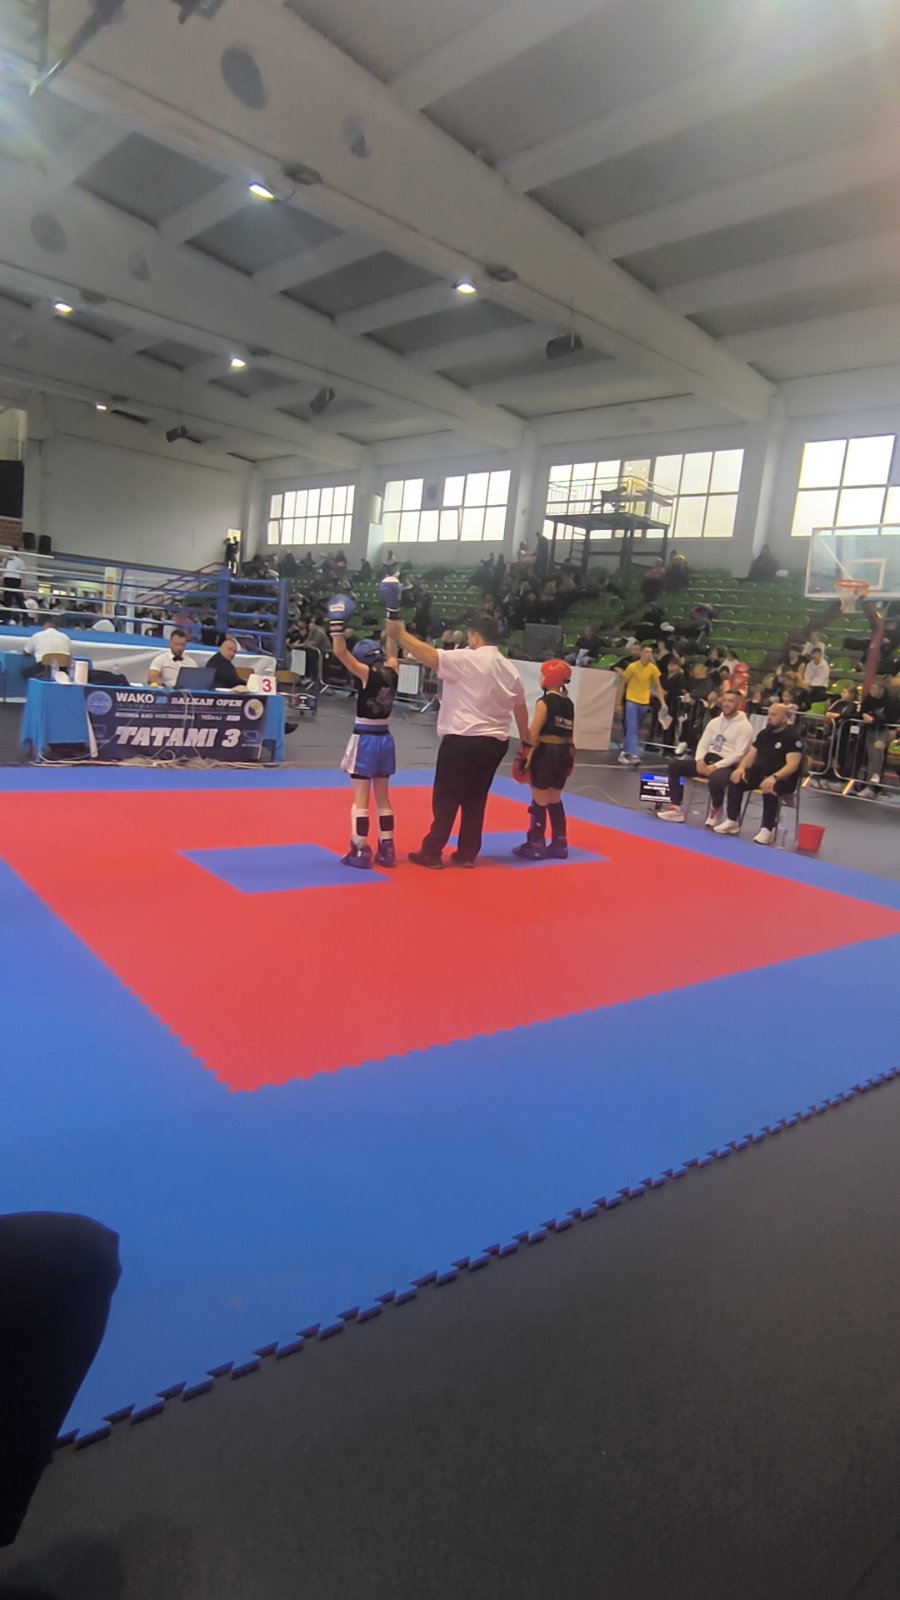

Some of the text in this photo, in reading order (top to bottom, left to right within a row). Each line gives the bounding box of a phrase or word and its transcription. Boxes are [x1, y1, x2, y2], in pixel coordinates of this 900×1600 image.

[262, 678, 272, 693] 3
[115, 692, 155, 704] WAKO
[171, 697, 215, 706] BALKAN
[216, 699, 244, 707] OPEN
[115, 726, 242, 748] TATAMI 3
